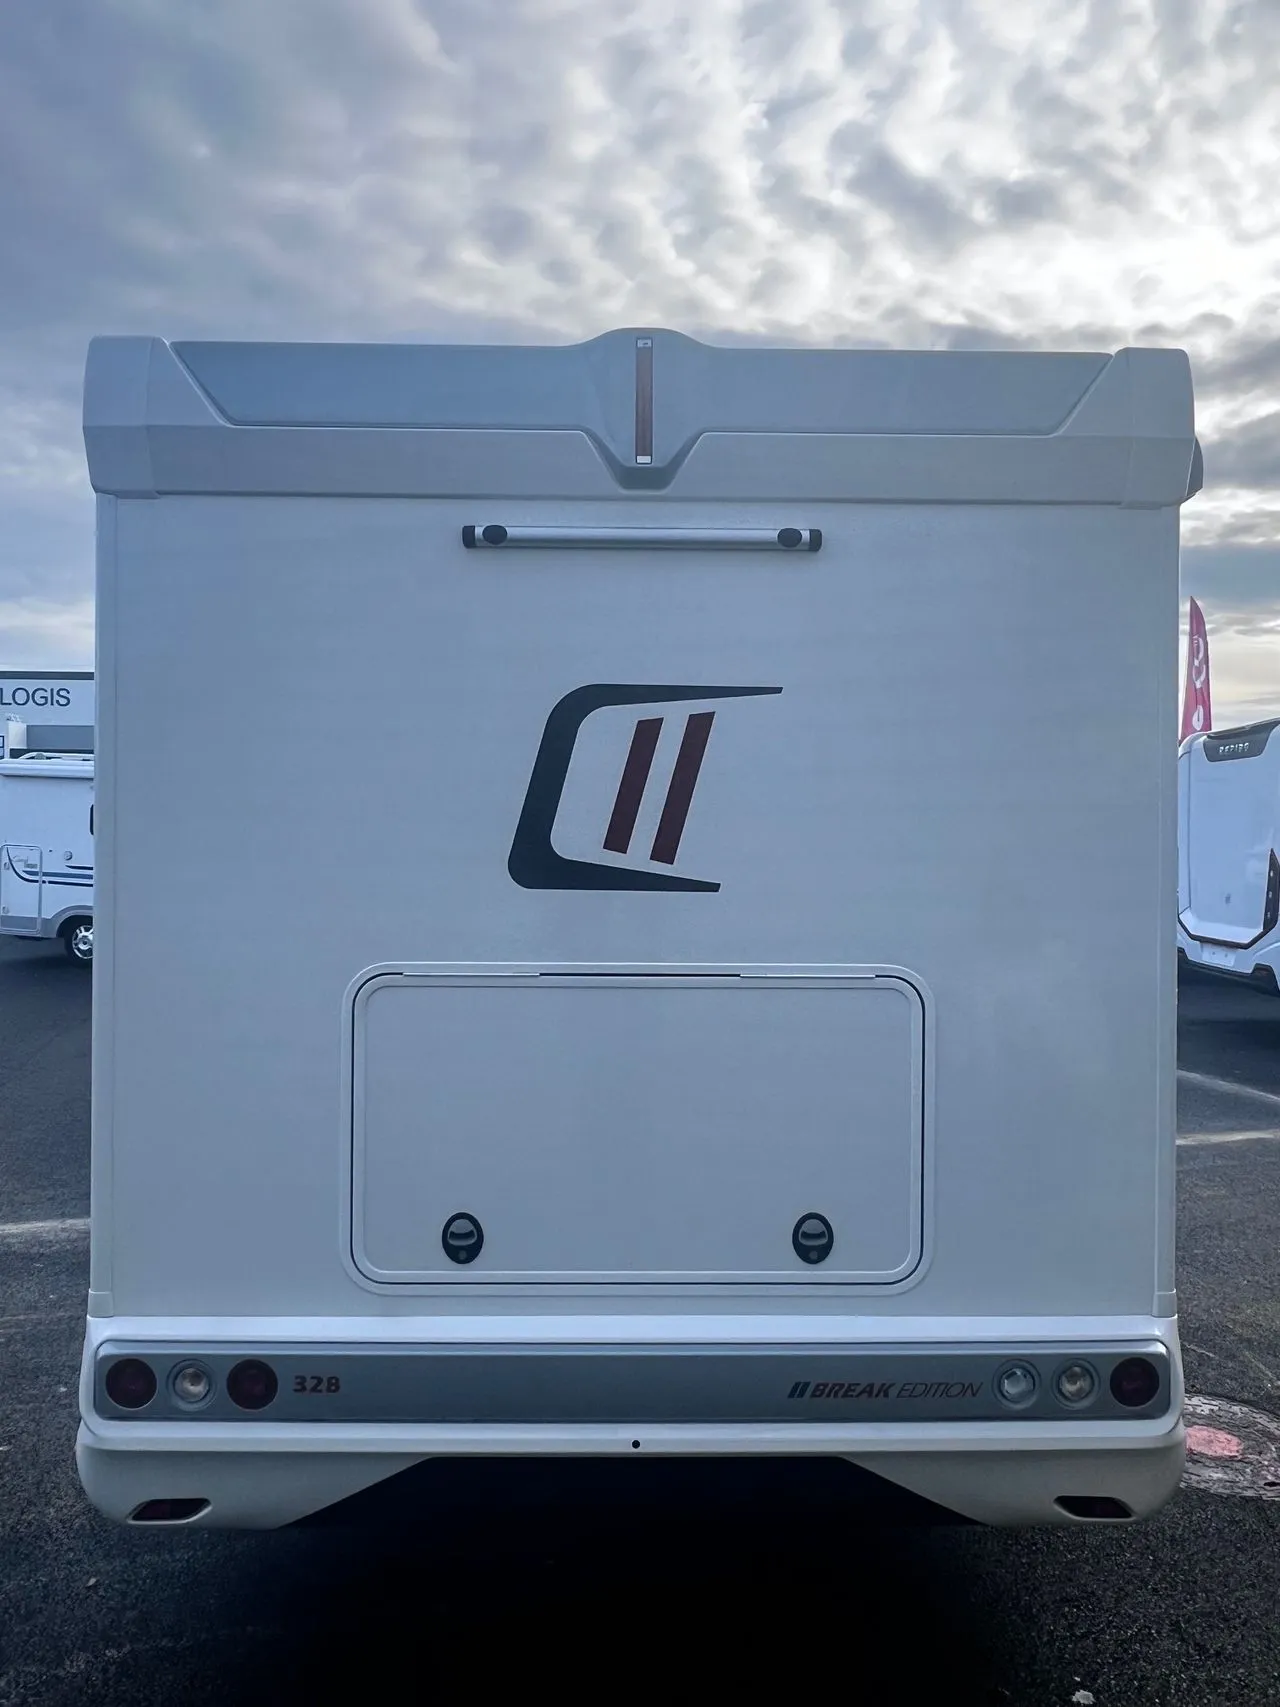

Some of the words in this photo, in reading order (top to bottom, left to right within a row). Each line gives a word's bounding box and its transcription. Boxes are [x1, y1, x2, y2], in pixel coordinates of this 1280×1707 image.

[0, 687, 71, 707] LOGIS
[292, 1375, 341, 1393] 328
[810, 1382, 895, 1399] BREAK
[896, 1382, 984, 1399] EDITION
